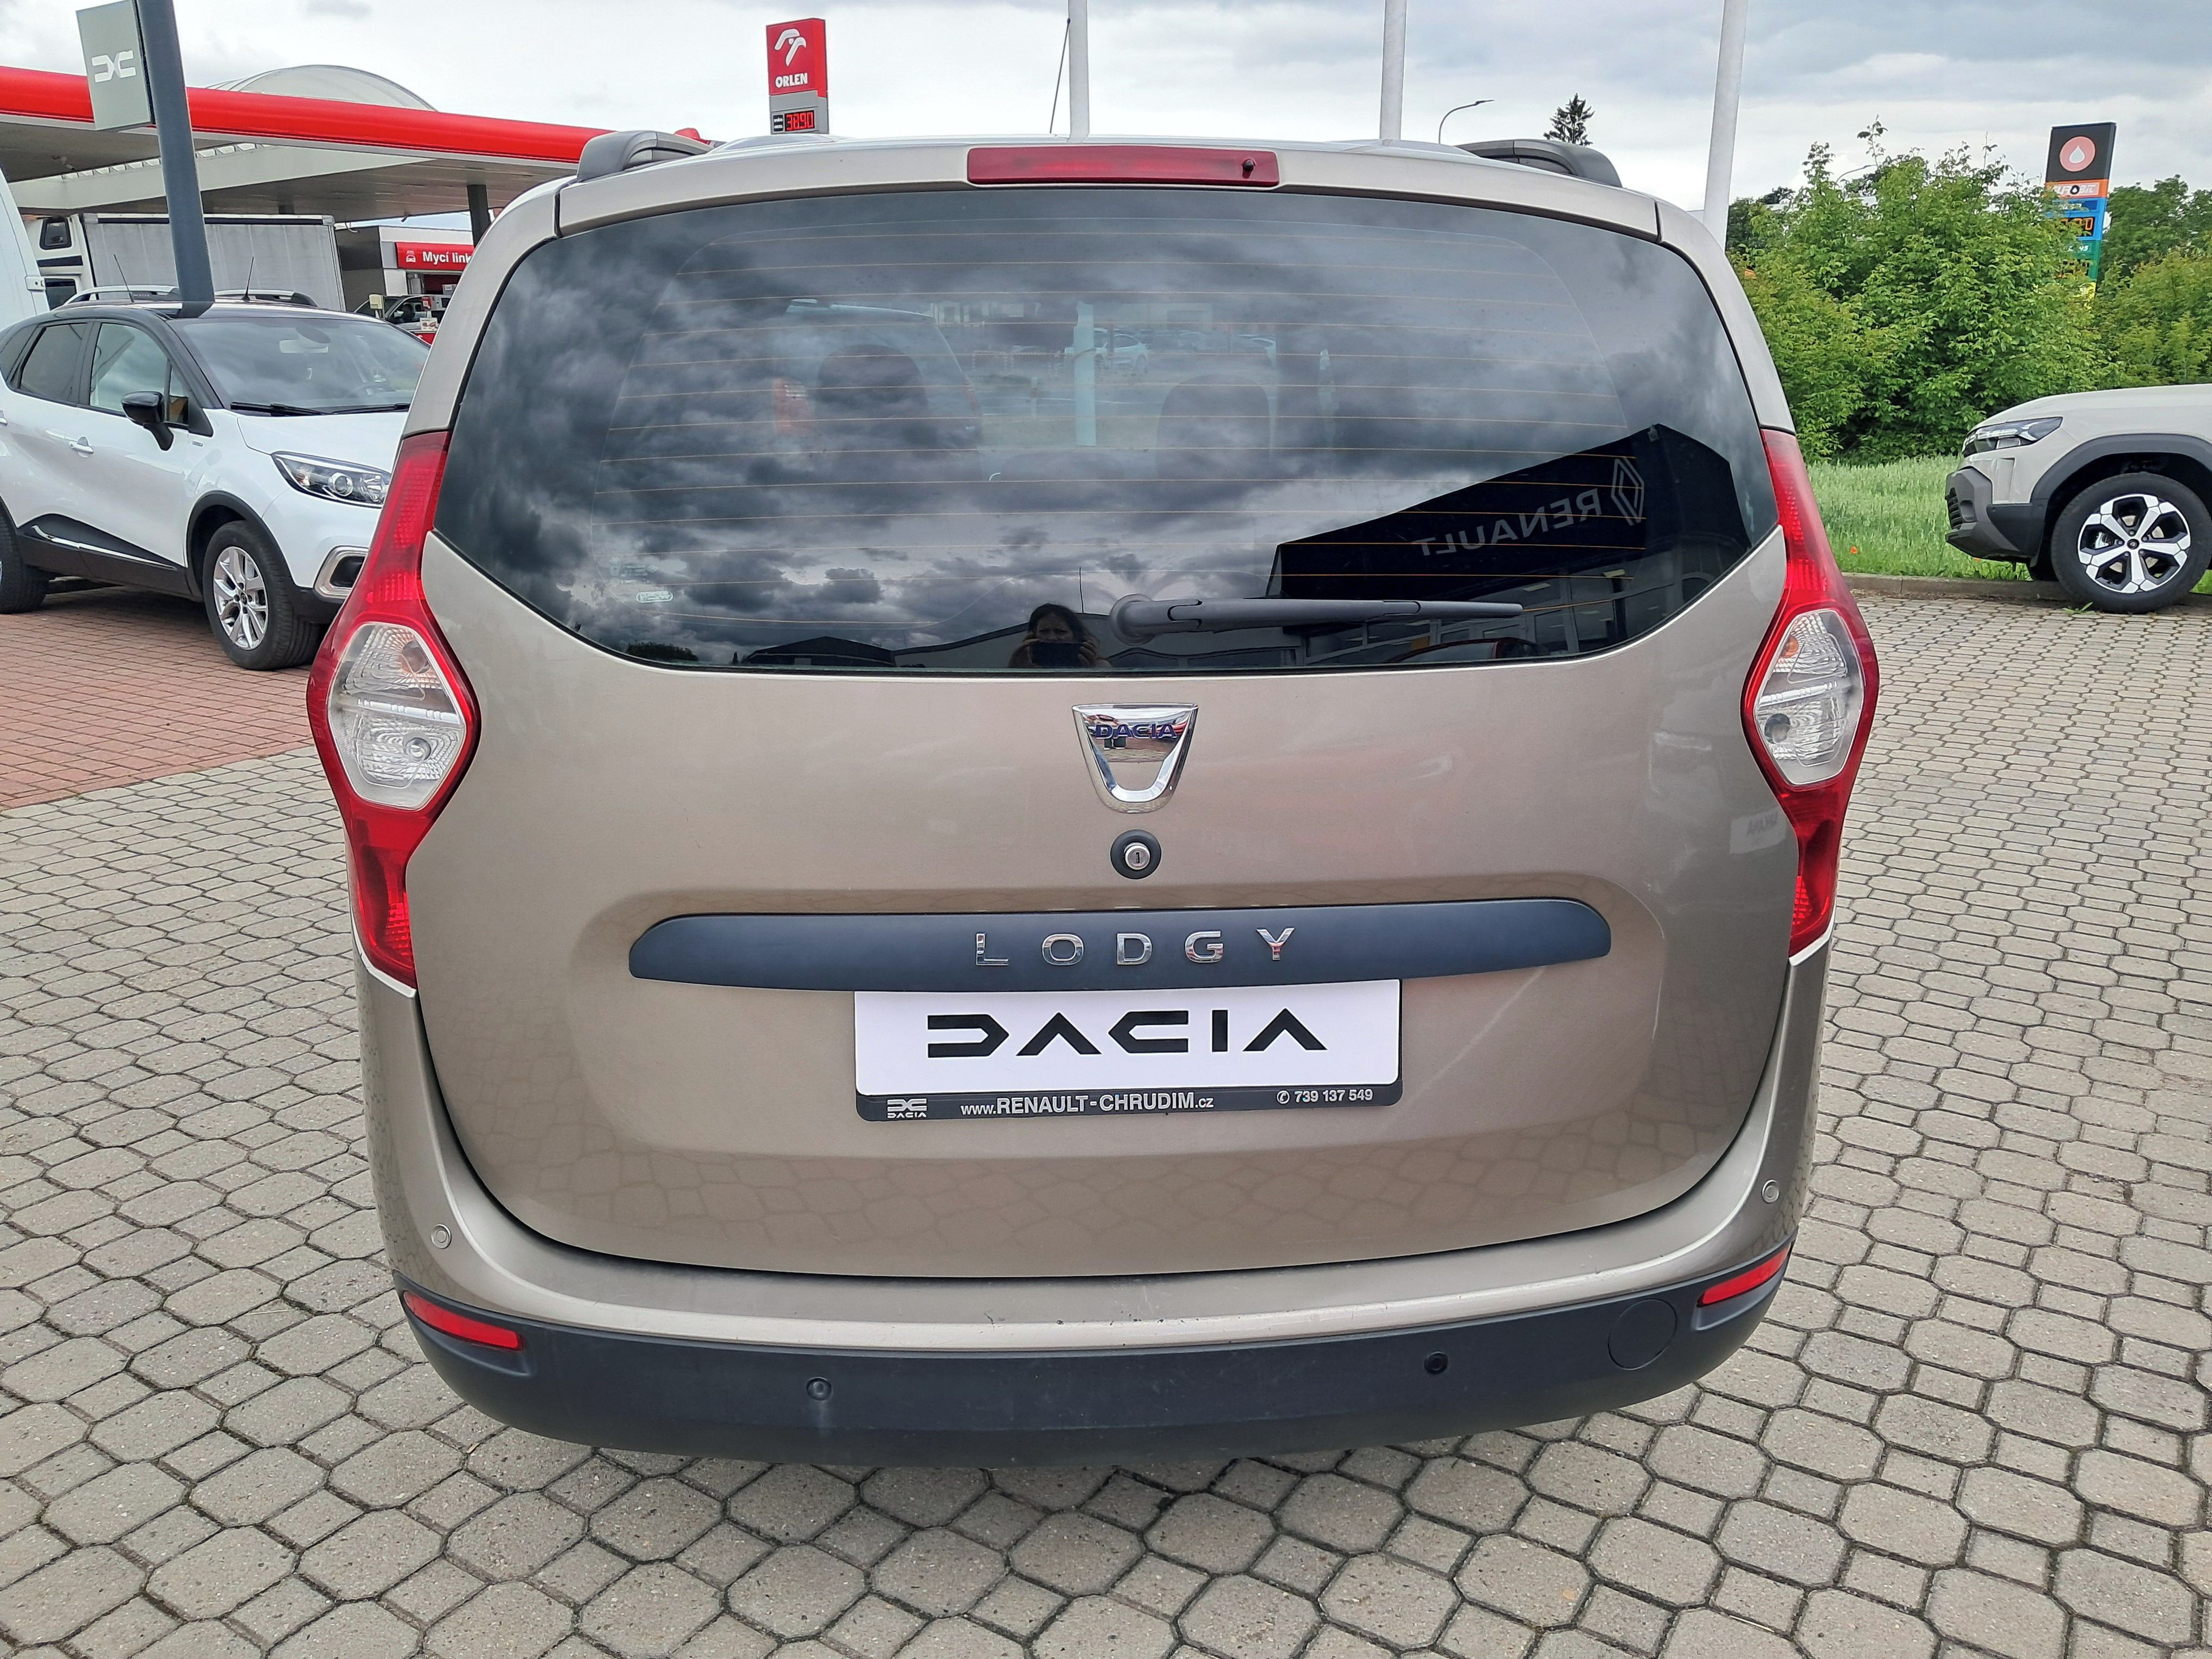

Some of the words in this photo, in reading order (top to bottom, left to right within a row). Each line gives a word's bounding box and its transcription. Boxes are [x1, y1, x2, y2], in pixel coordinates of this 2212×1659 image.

[775, 72, 808, 88] ORLEN
[422, 251, 449, 265] Mycí
[1095, 723, 1178, 739] DACIA
[975, 927, 1296, 966] LODGY
[928, 1008, 1328, 1058] DACIA
[961, 1092, 1214, 1115] www.RENAULT-CHRUDIM.cz
[1294, 1090, 1319, 1103] 739
[1322, 1090, 1345, 1102] 137
[1348, 1089, 1373, 1101] 549
